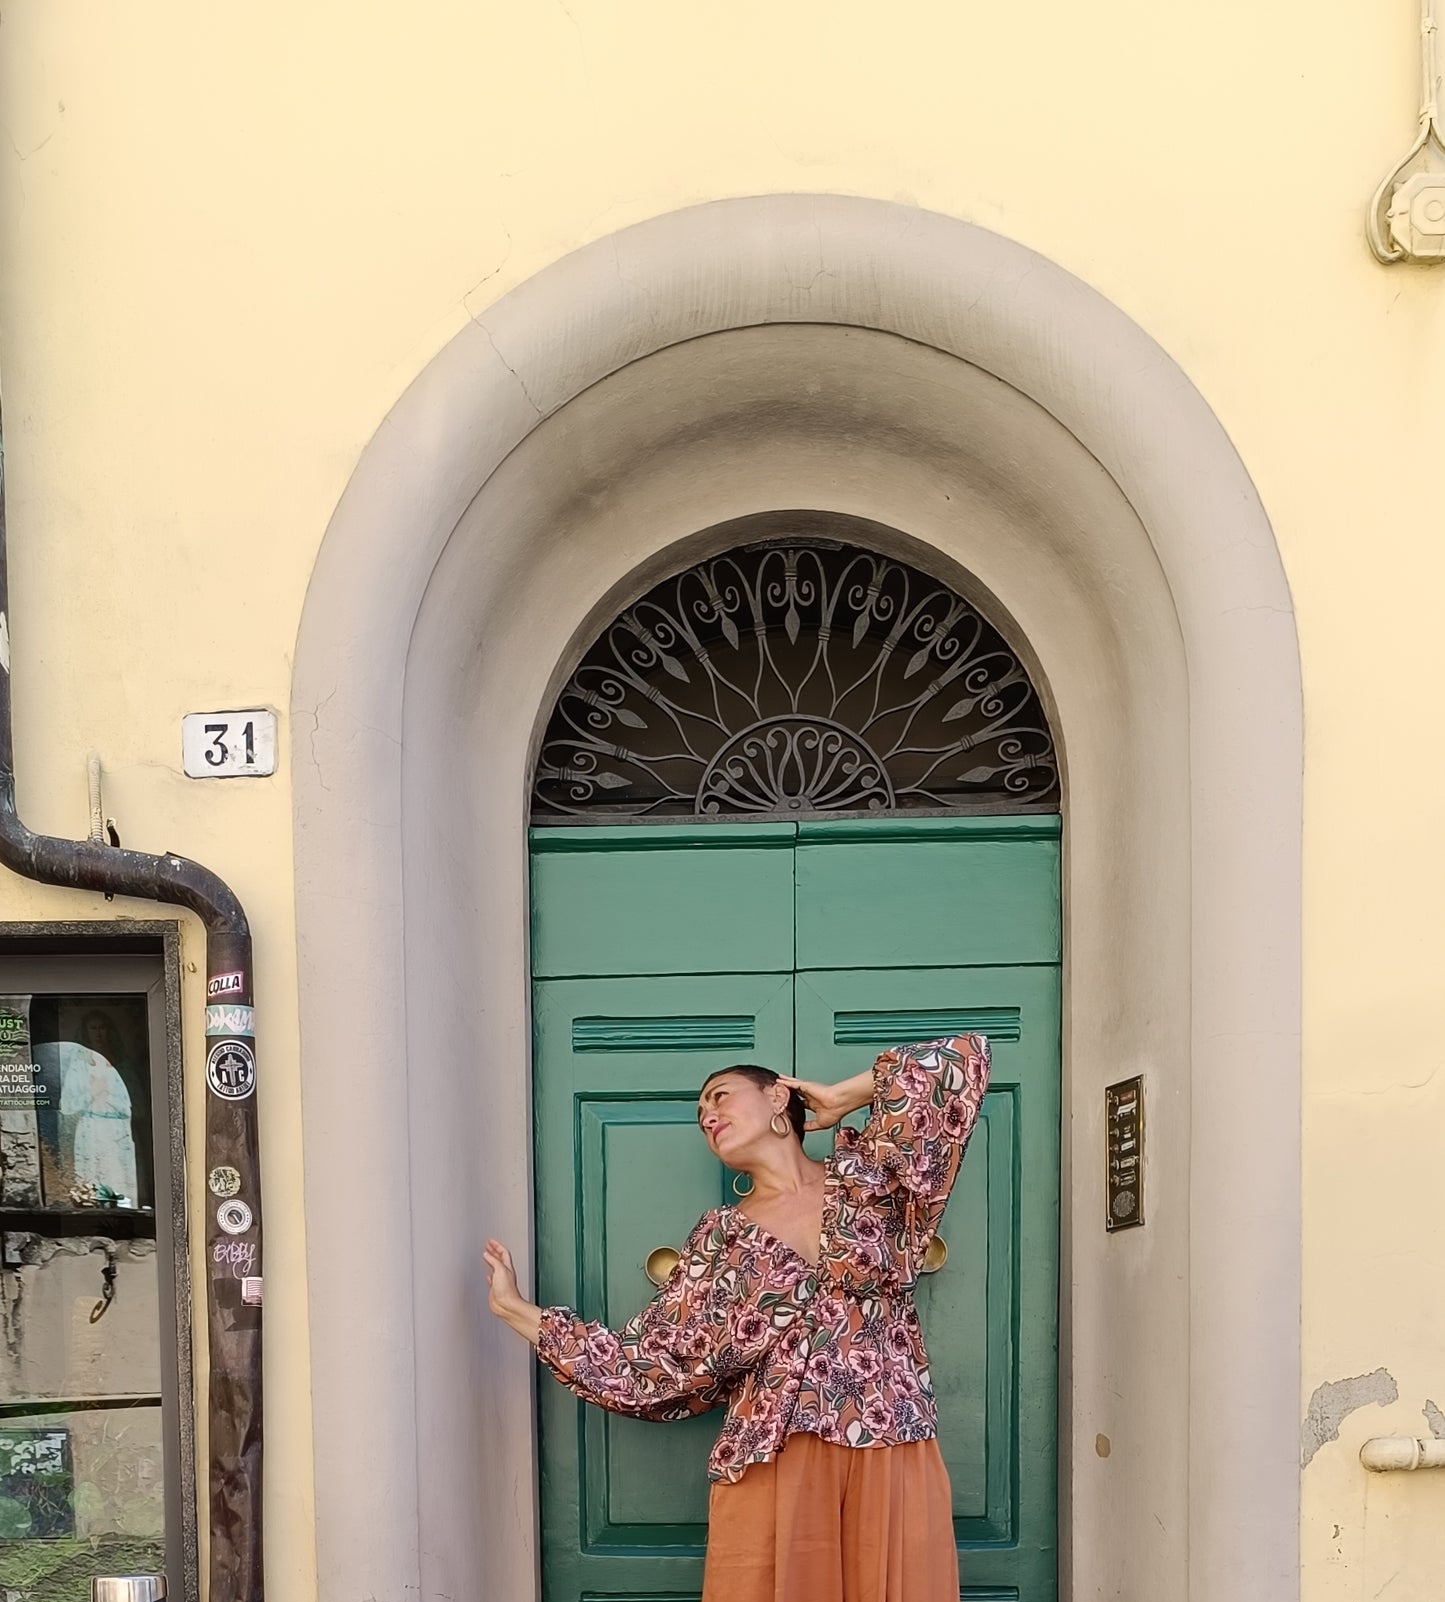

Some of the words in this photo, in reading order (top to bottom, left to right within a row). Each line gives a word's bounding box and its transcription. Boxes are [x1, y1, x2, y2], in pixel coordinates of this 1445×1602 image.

[204, 721, 254, 766] 31
[208, 975, 241, 994] COLLA
[0, 1064, 41, 1072] NDIAMO
[11, 1075, 30, 1083] DEL
